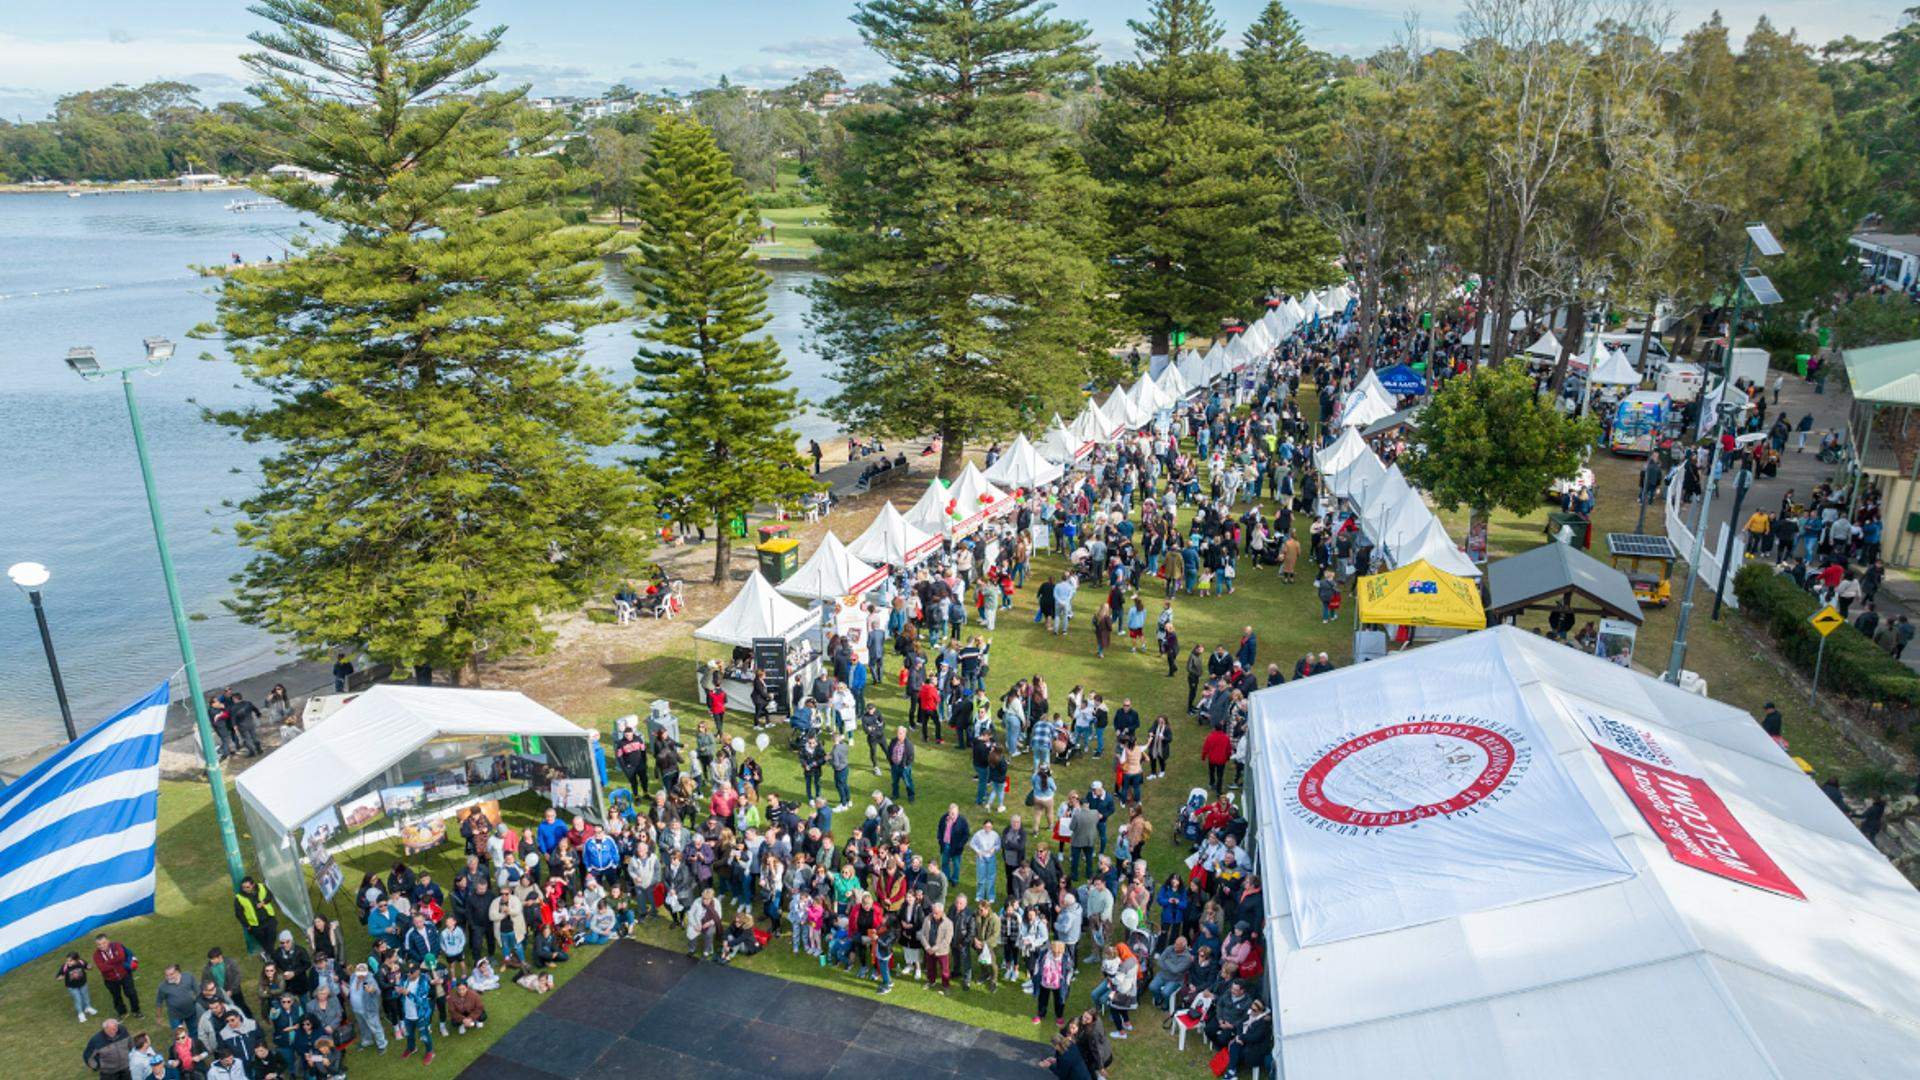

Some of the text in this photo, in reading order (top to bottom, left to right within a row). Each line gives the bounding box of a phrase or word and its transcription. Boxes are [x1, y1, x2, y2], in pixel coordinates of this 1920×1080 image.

[1385, 725, 1474, 737] ORTHODOX
[1330, 735, 1376, 761] GREEK
[1461, 790, 1480, 802] OF
[1347, 802, 1451, 825] AUSTRALIA
[1652, 771, 1757, 875] WELCOME
